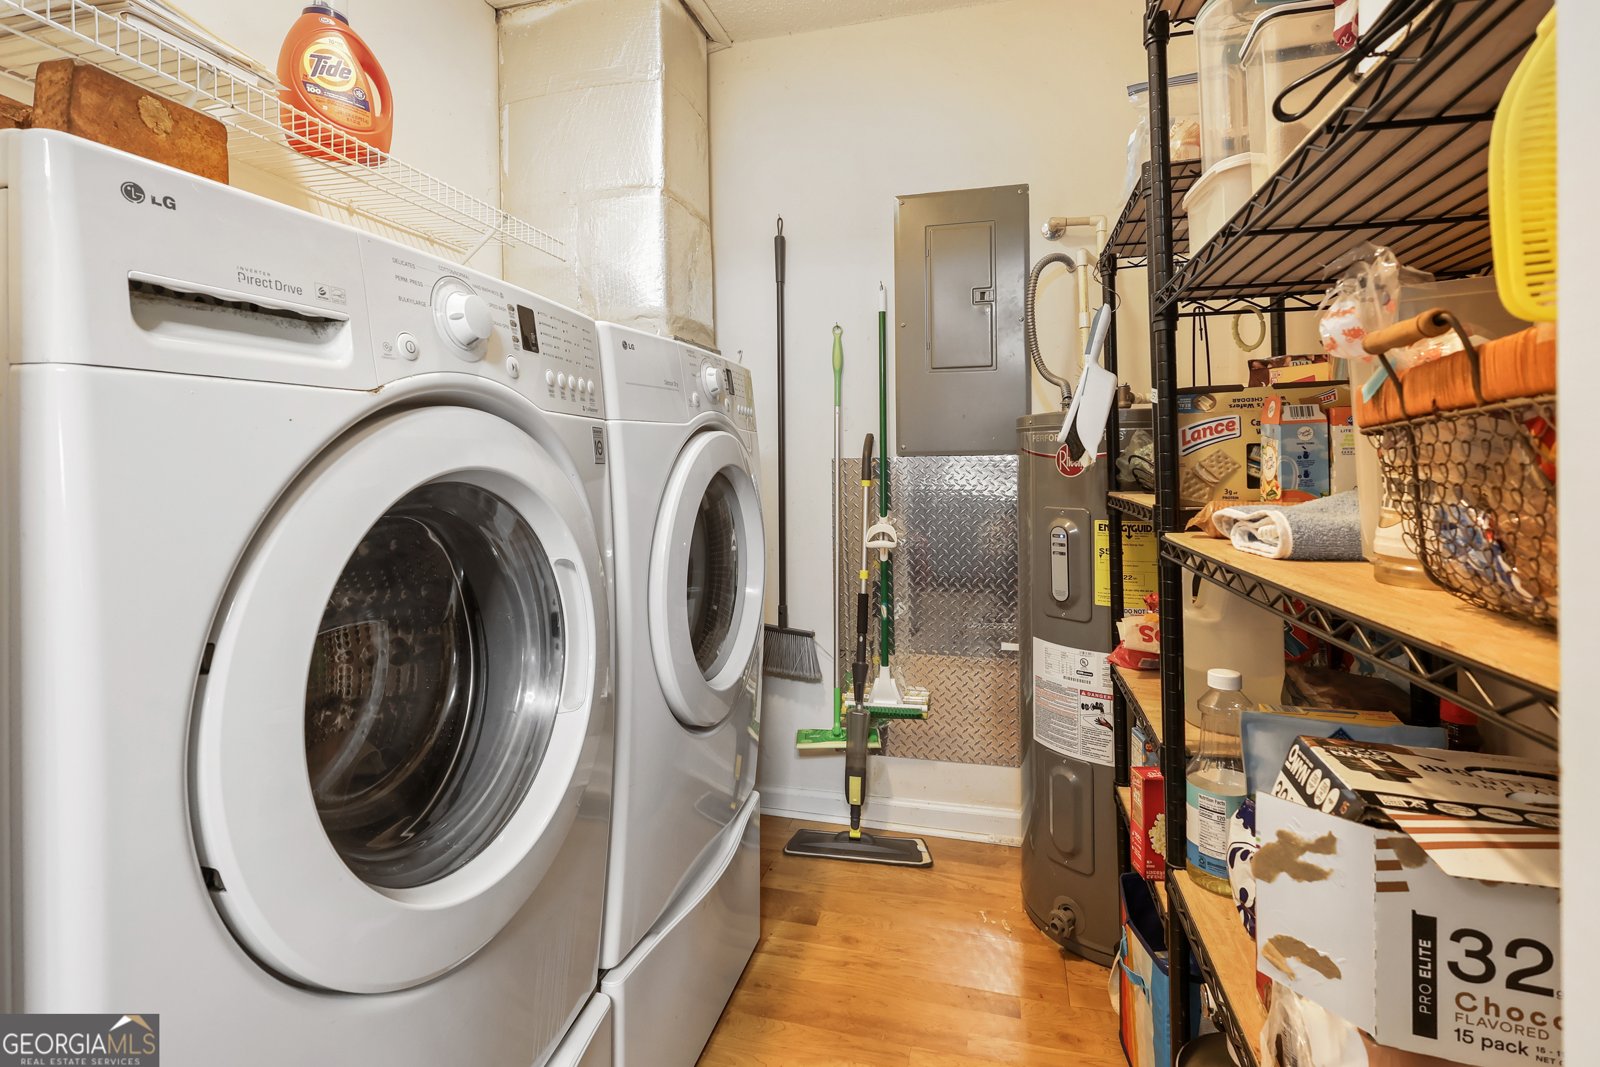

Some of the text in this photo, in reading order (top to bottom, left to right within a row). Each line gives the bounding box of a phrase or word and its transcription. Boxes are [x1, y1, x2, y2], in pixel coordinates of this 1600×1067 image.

[309, 54, 352, 79] Tide
[150, 195, 176, 210] LG
[275, 279, 303, 296] Drive
[1181, 419, 1237, 447] Lance
[1418, 938, 1432, 1014] PRO ELITE
[1454, 1012, 1550, 1041] FLAVORED
[1454, 1028, 1529, 1057] 15 pack
